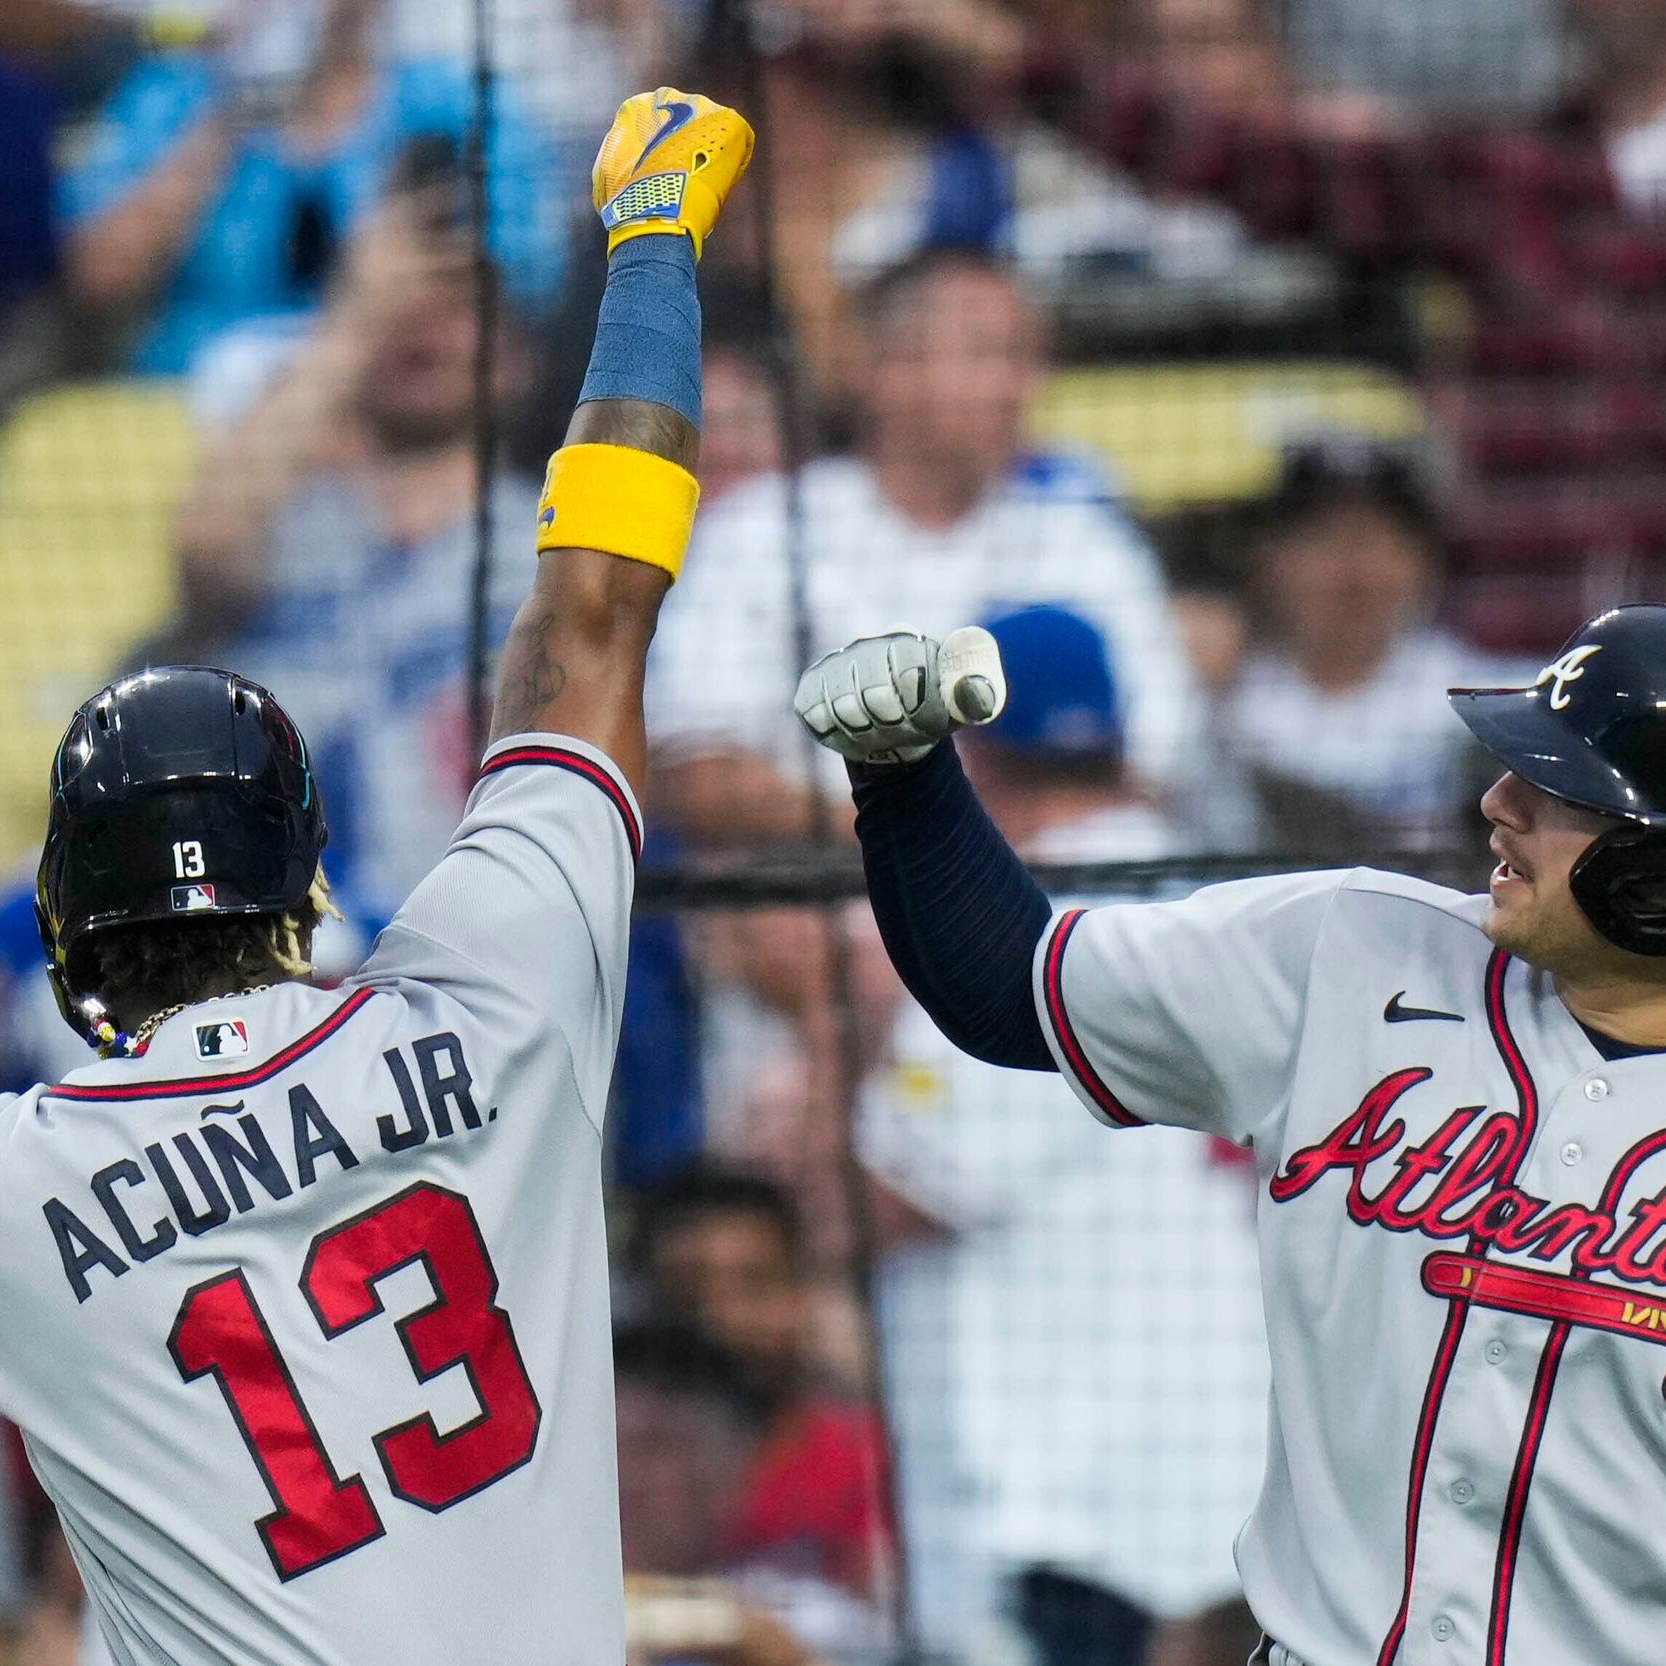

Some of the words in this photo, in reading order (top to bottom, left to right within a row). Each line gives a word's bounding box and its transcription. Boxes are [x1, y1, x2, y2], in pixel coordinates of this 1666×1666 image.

[172, 840, 206, 879] 13
[42, 1082, 360, 1304] ACUÑA
[376, 1031, 498, 1153] JR.
[166, 1179, 543, 1584] 13
